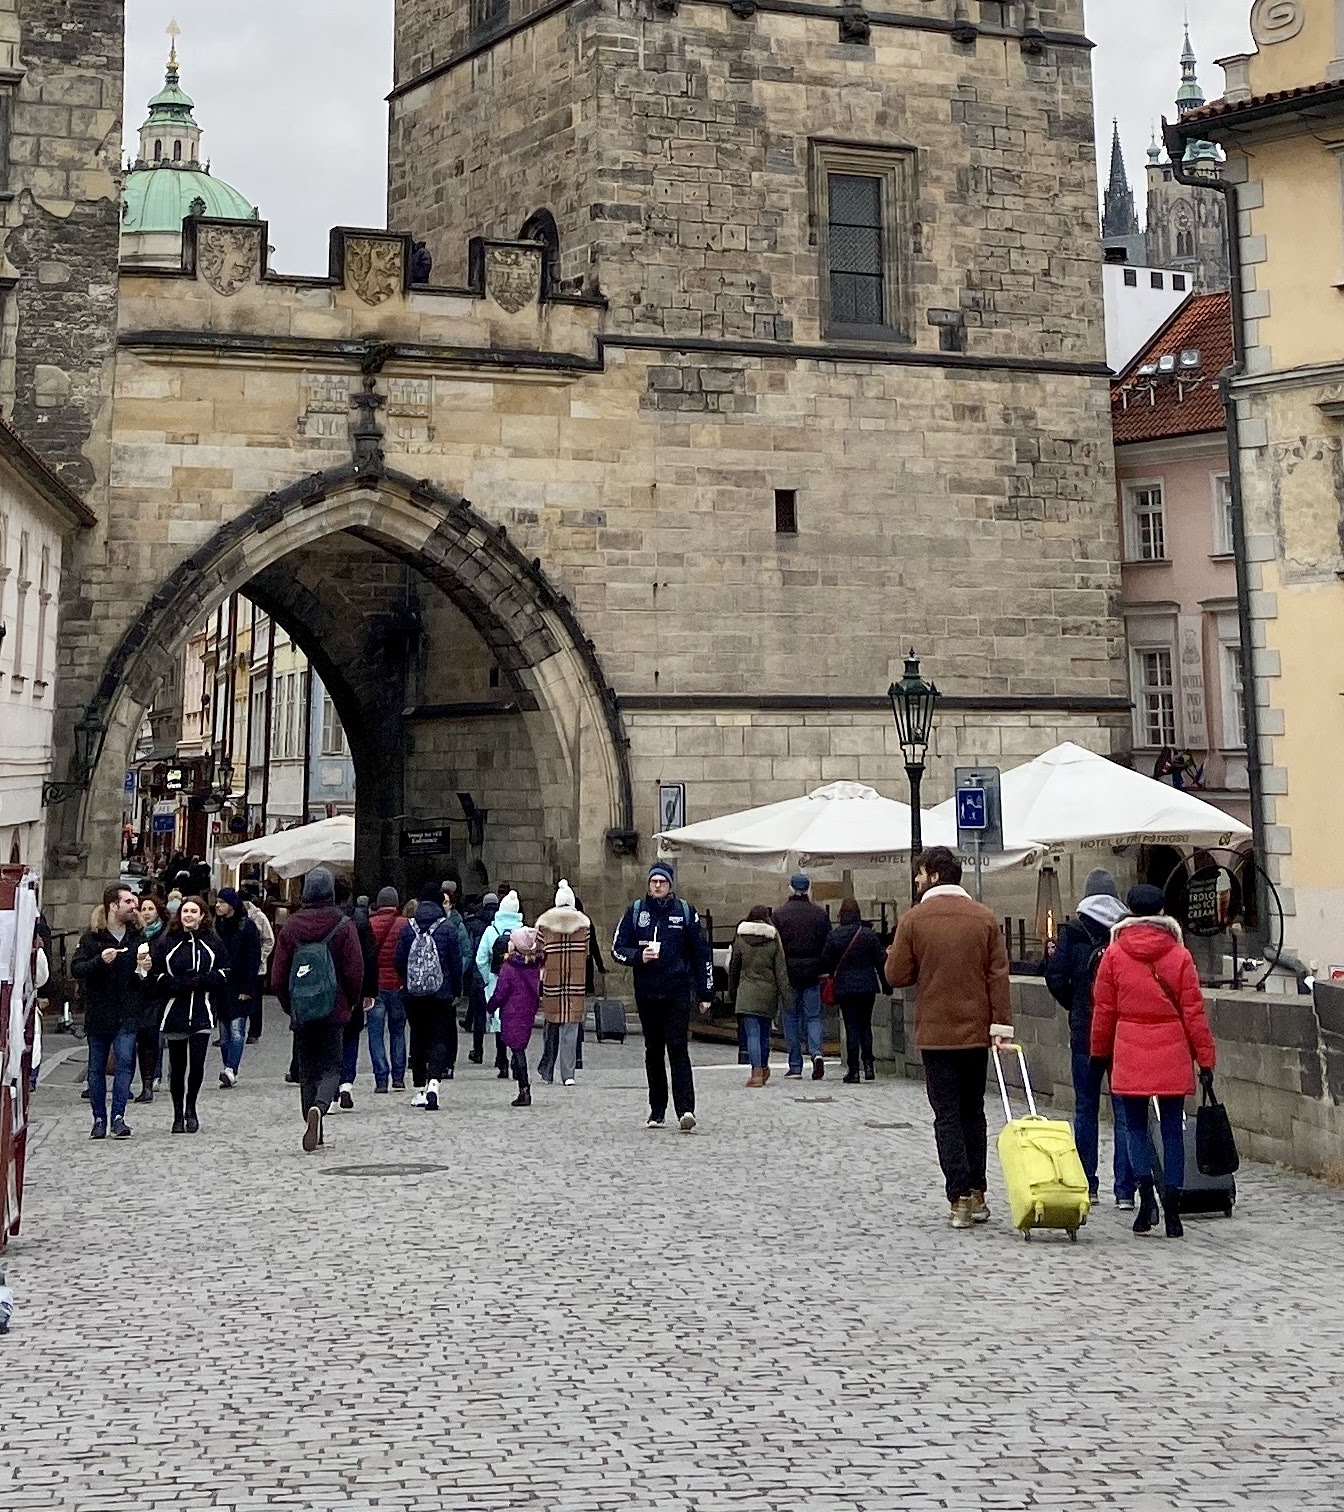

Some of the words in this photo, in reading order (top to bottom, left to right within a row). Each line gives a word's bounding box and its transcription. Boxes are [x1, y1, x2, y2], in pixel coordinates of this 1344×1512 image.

[1080, 838, 1113, 849] HOTEL
[869, 854, 906, 864] HOTEL
[1188, 908, 1215, 918] CREAM
